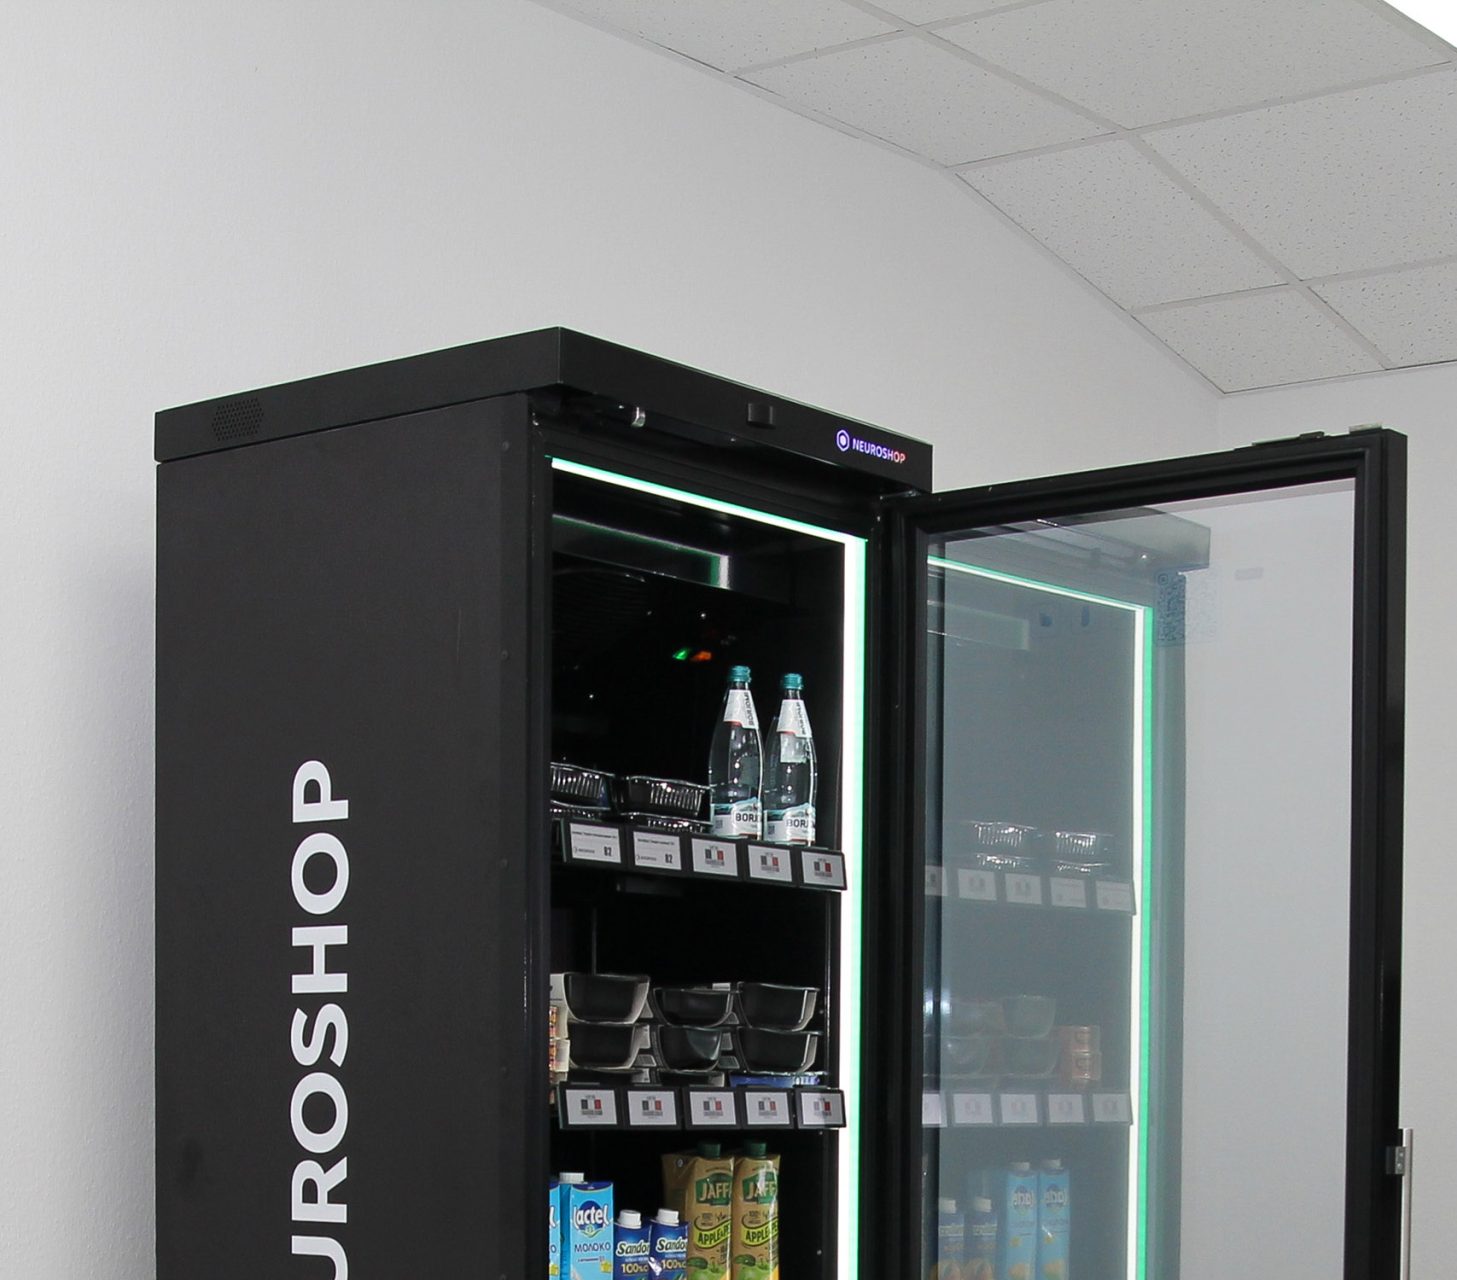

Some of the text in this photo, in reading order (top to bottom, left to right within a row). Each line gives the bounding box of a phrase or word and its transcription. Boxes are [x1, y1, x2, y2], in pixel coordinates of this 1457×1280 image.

[852, 438, 906, 464] NEUROSHOP
[735, 812, 758, 823] BORJ
[699, 1182, 731, 1202] JAFF
[746, 1181, 777, 1201] JAFF
